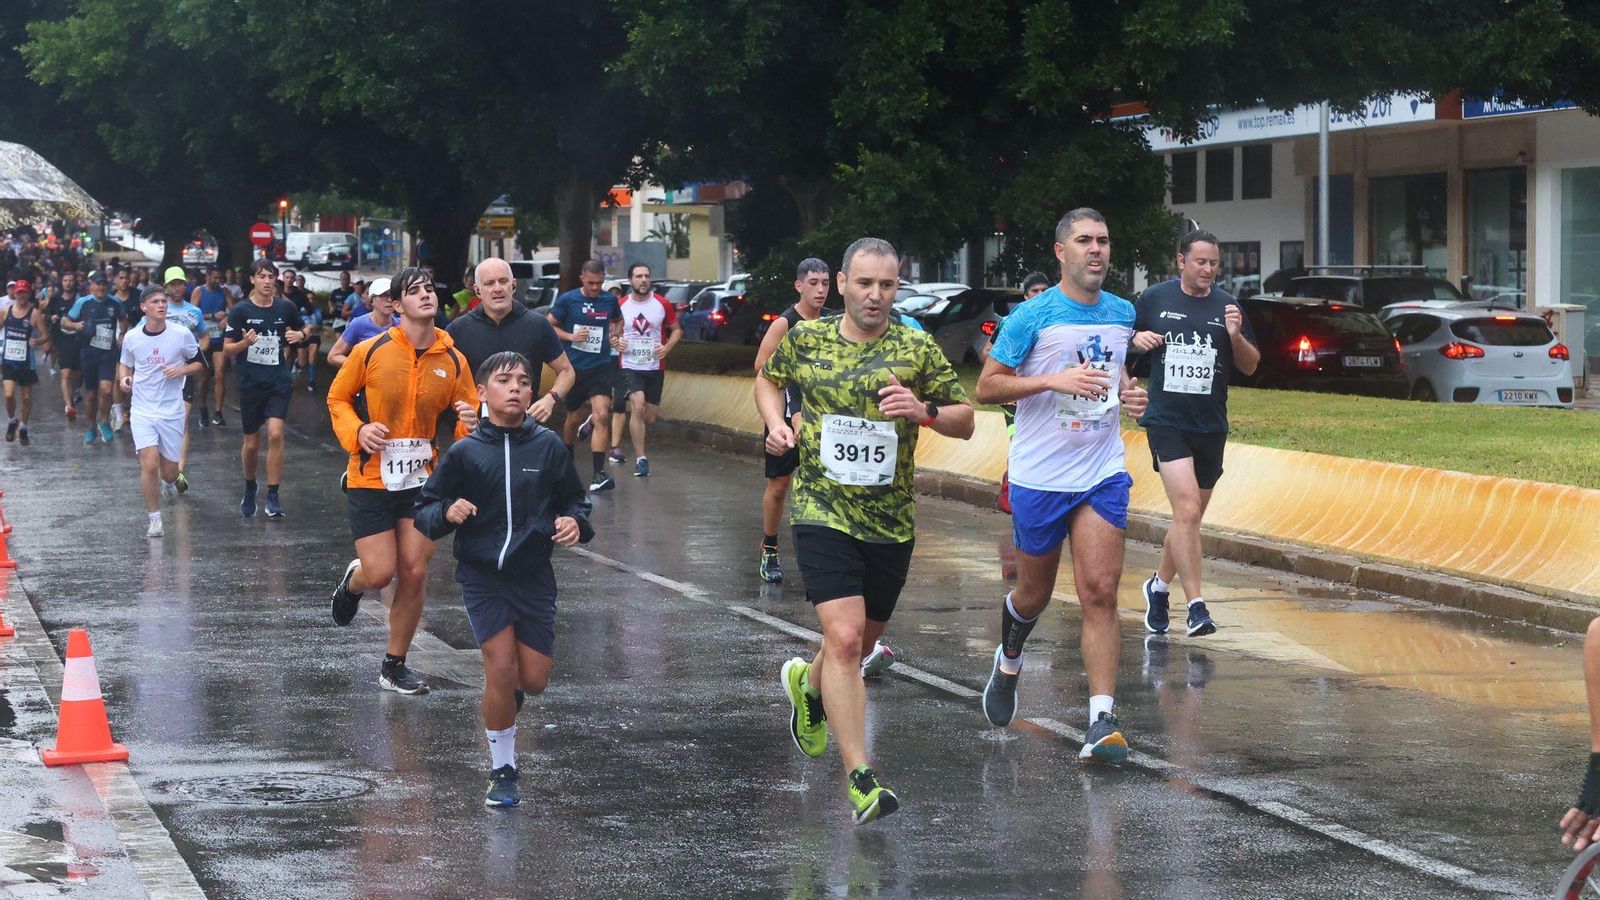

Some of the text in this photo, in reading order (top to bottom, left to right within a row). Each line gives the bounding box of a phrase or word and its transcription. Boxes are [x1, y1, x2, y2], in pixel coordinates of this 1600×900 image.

[255, 347, 275, 356] 7497
[1169, 364, 1211, 379] 11332
[833, 443, 886, 464] 3915
